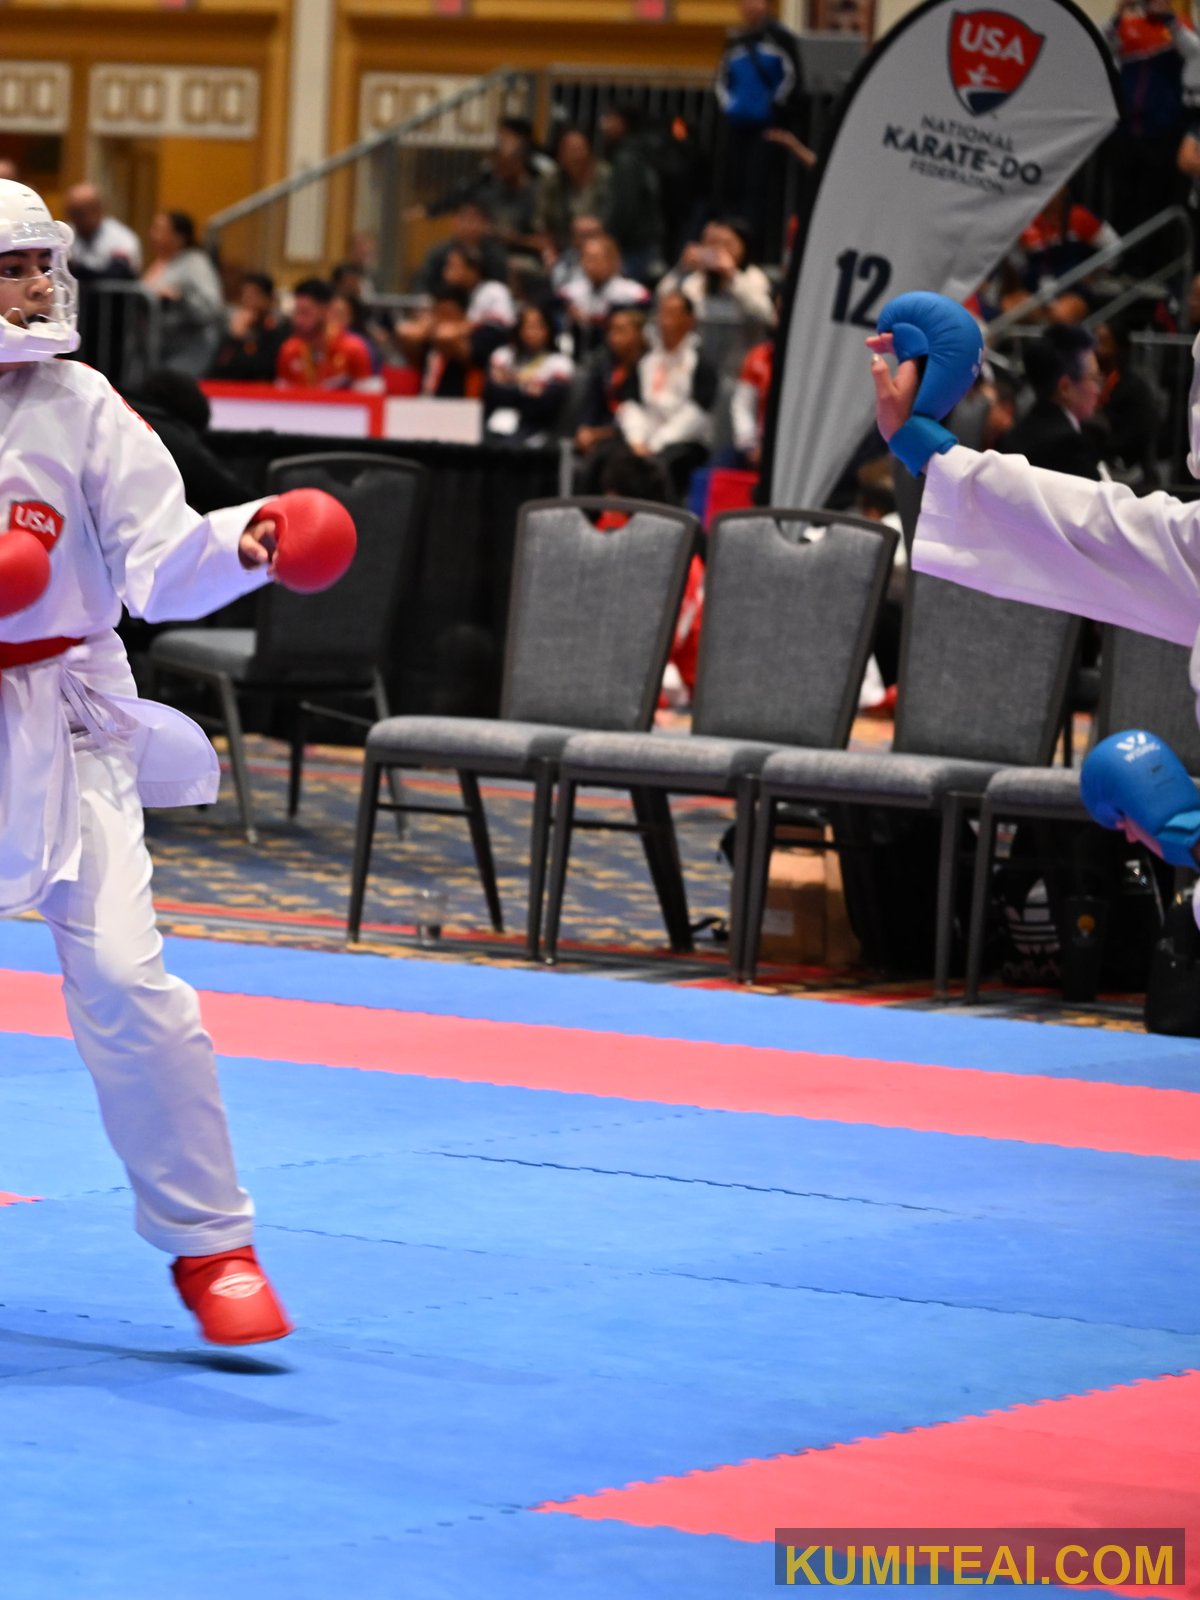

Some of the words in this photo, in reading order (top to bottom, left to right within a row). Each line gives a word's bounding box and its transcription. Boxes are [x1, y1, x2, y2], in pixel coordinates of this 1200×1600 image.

[960, 20, 1025, 65] USA
[883, 123, 1043, 186] KARATE-DO
[921, 115, 1013, 152] NATIONAL
[831, 249, 892, 328] 12
[15, 505, 57, 537] USA
